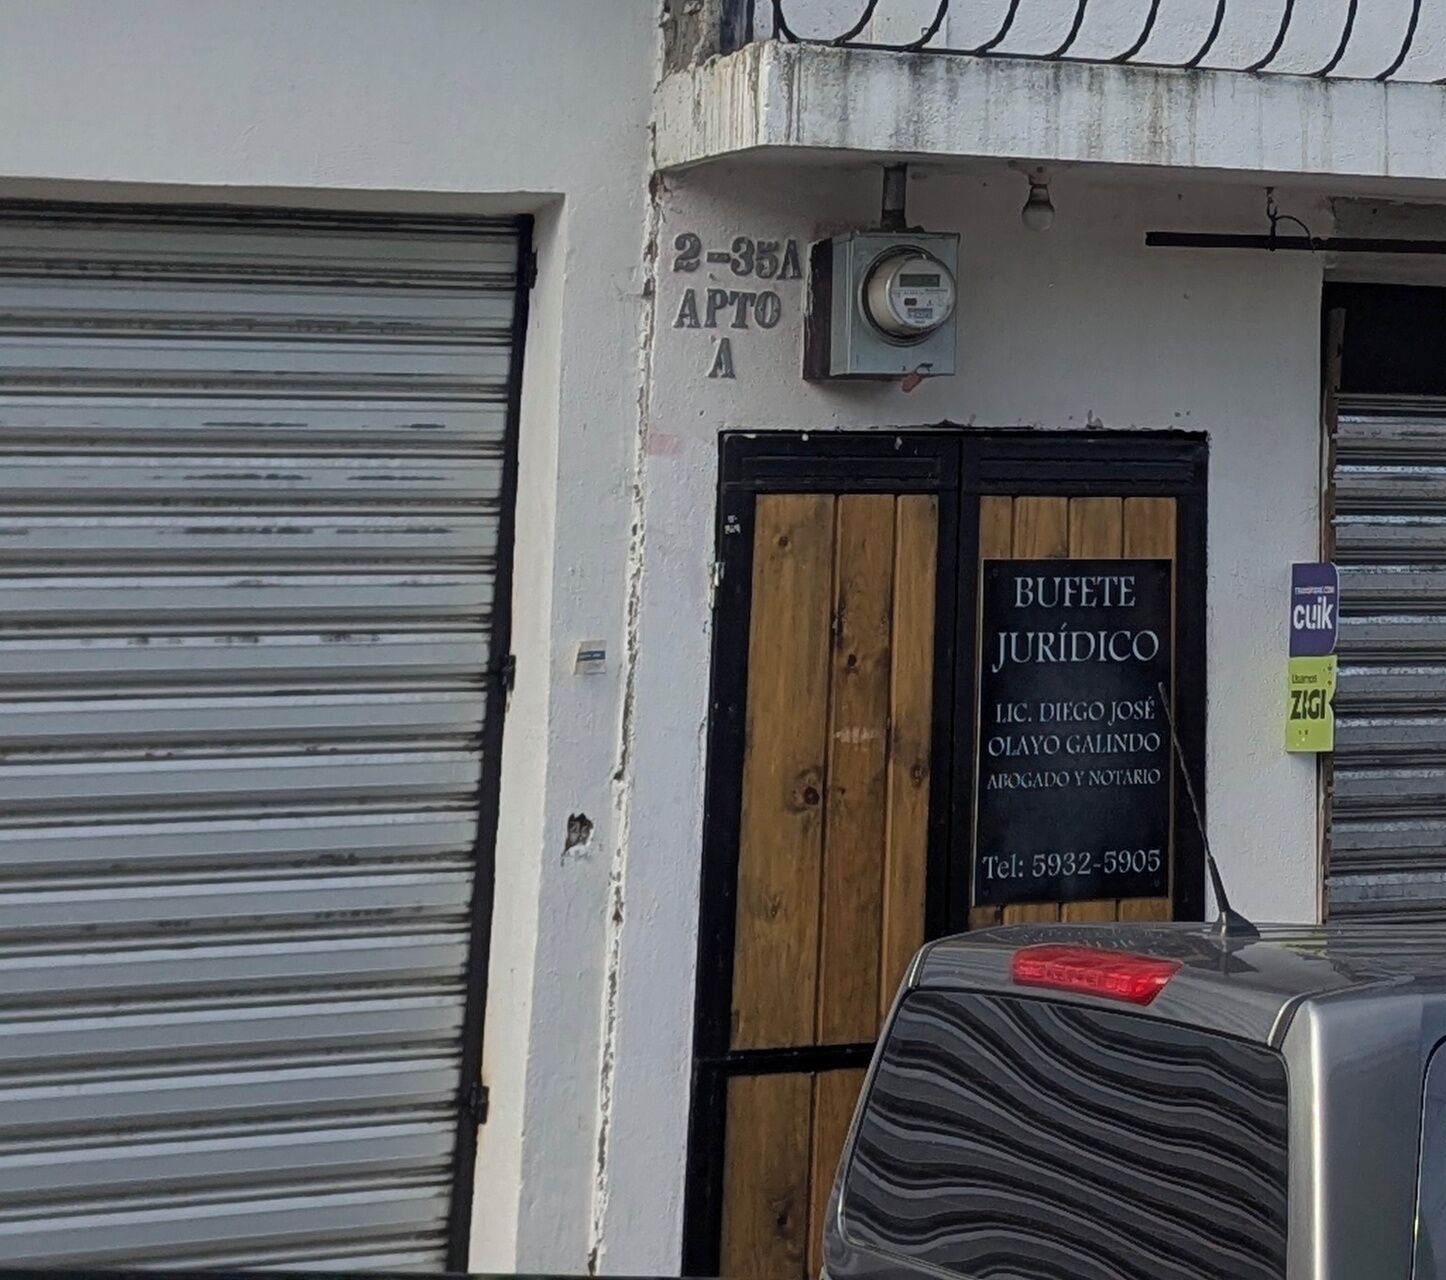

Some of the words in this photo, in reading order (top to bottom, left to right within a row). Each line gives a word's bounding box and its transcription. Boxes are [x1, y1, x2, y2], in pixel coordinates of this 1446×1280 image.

[673, 287, 782, 329] APTO
[707, 337, 736, 379] A
[1014, 575, 1136, 609] BUFETE
[991, 622, 1160, 673] JURÍDICO
[995, 702, 1032, 724] LIC.
[1039, 701, 1105, 723] DIEGO
[1107, 696, 1156, 727] JOSÉ
[1290, 689, 1327, 720] ZIGI
[987, 735, 1061, 757] OLAYO
[1066, 732, 1161, 755] GALINDO
[986, 771, 1070, 790] ABOGADO
[1074, 770, 1086, 786] Y
[1088, 768, 1161, 788] NOTARIO
[981, 853, 1025, 880] Tel:
[1031, 848, 1162, 878] 5932-5905
